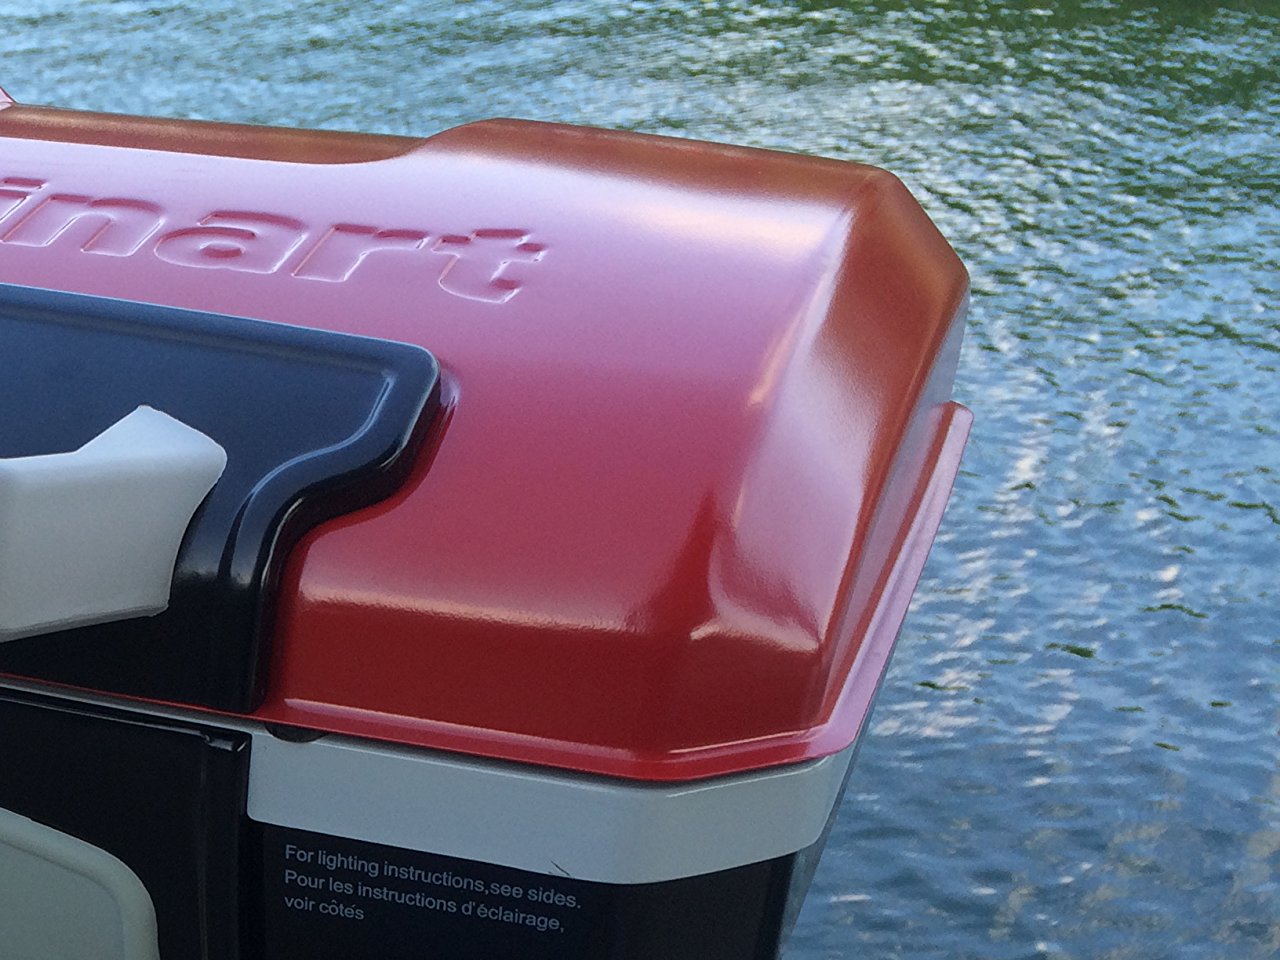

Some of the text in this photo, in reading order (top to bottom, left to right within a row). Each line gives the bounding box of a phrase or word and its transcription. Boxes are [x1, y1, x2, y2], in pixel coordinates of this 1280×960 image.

[284, 869, 326, 889] Pour
[329, 877, 354, 895] les
[358, 882, 457, 913] instructions
[285, 844, 315, 863] For
[317, 850, 380, 878] lighting
[527, 887, 581, 909] sides.
[284, 896, 365, 920] voir côtés
